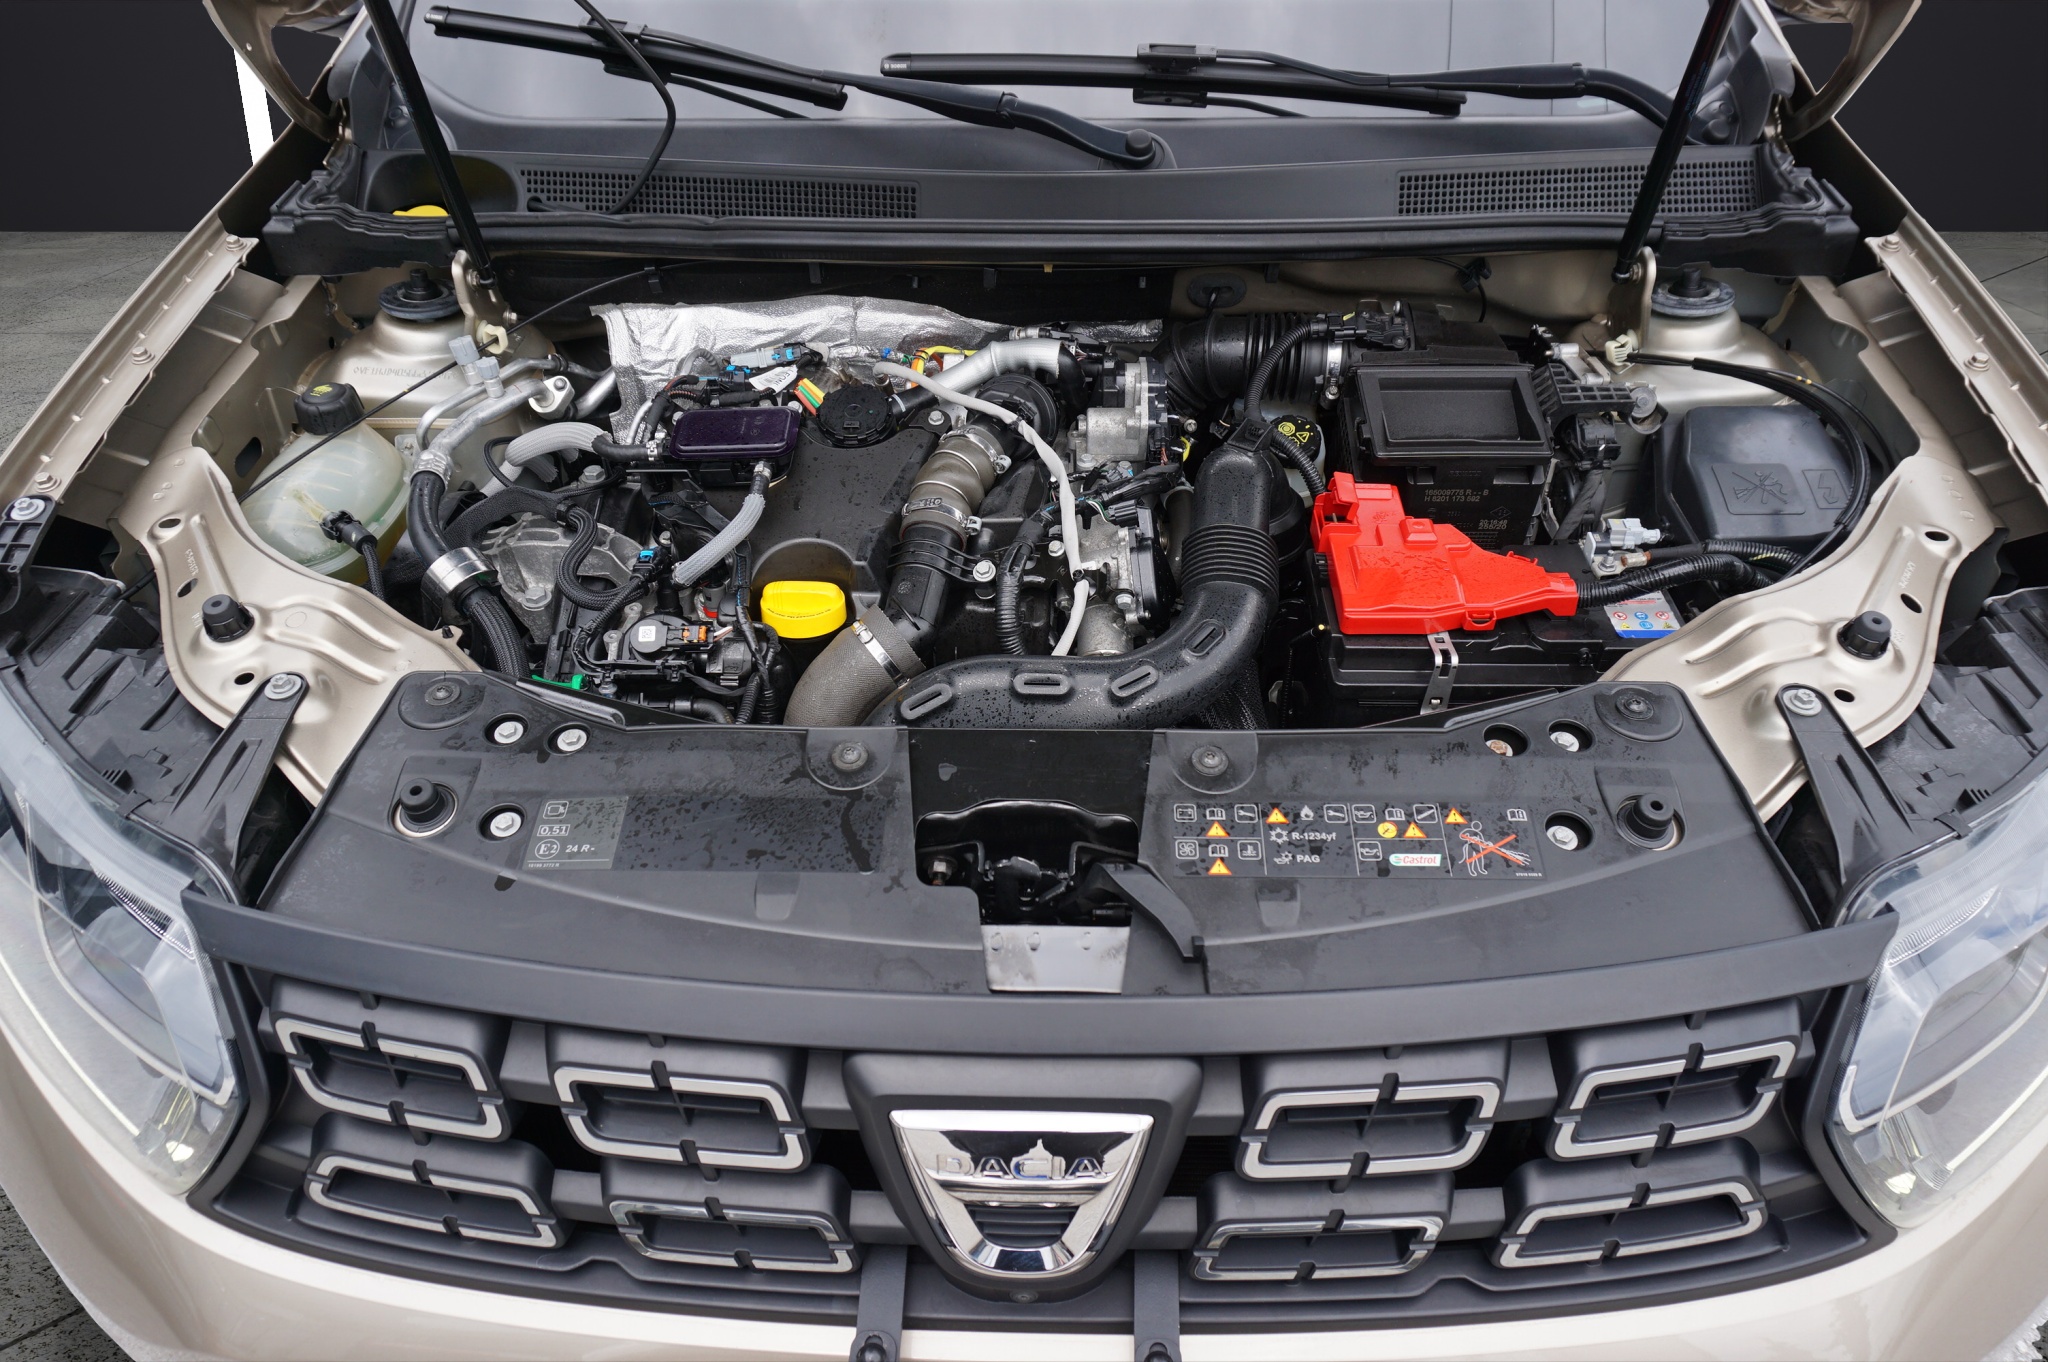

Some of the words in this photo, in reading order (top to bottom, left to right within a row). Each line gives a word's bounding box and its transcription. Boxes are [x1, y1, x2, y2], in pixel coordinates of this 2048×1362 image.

[540, 826, 567, 836] 0,51
[1291, 832, 1337, 842] R-1234yf
[565, 844, 578, 853] 24
[1296, 854, 1321, 863] PAG
[1402, 855, 1437, 865] Castrol
[935, 1153, 1109, 1180] DACIA
